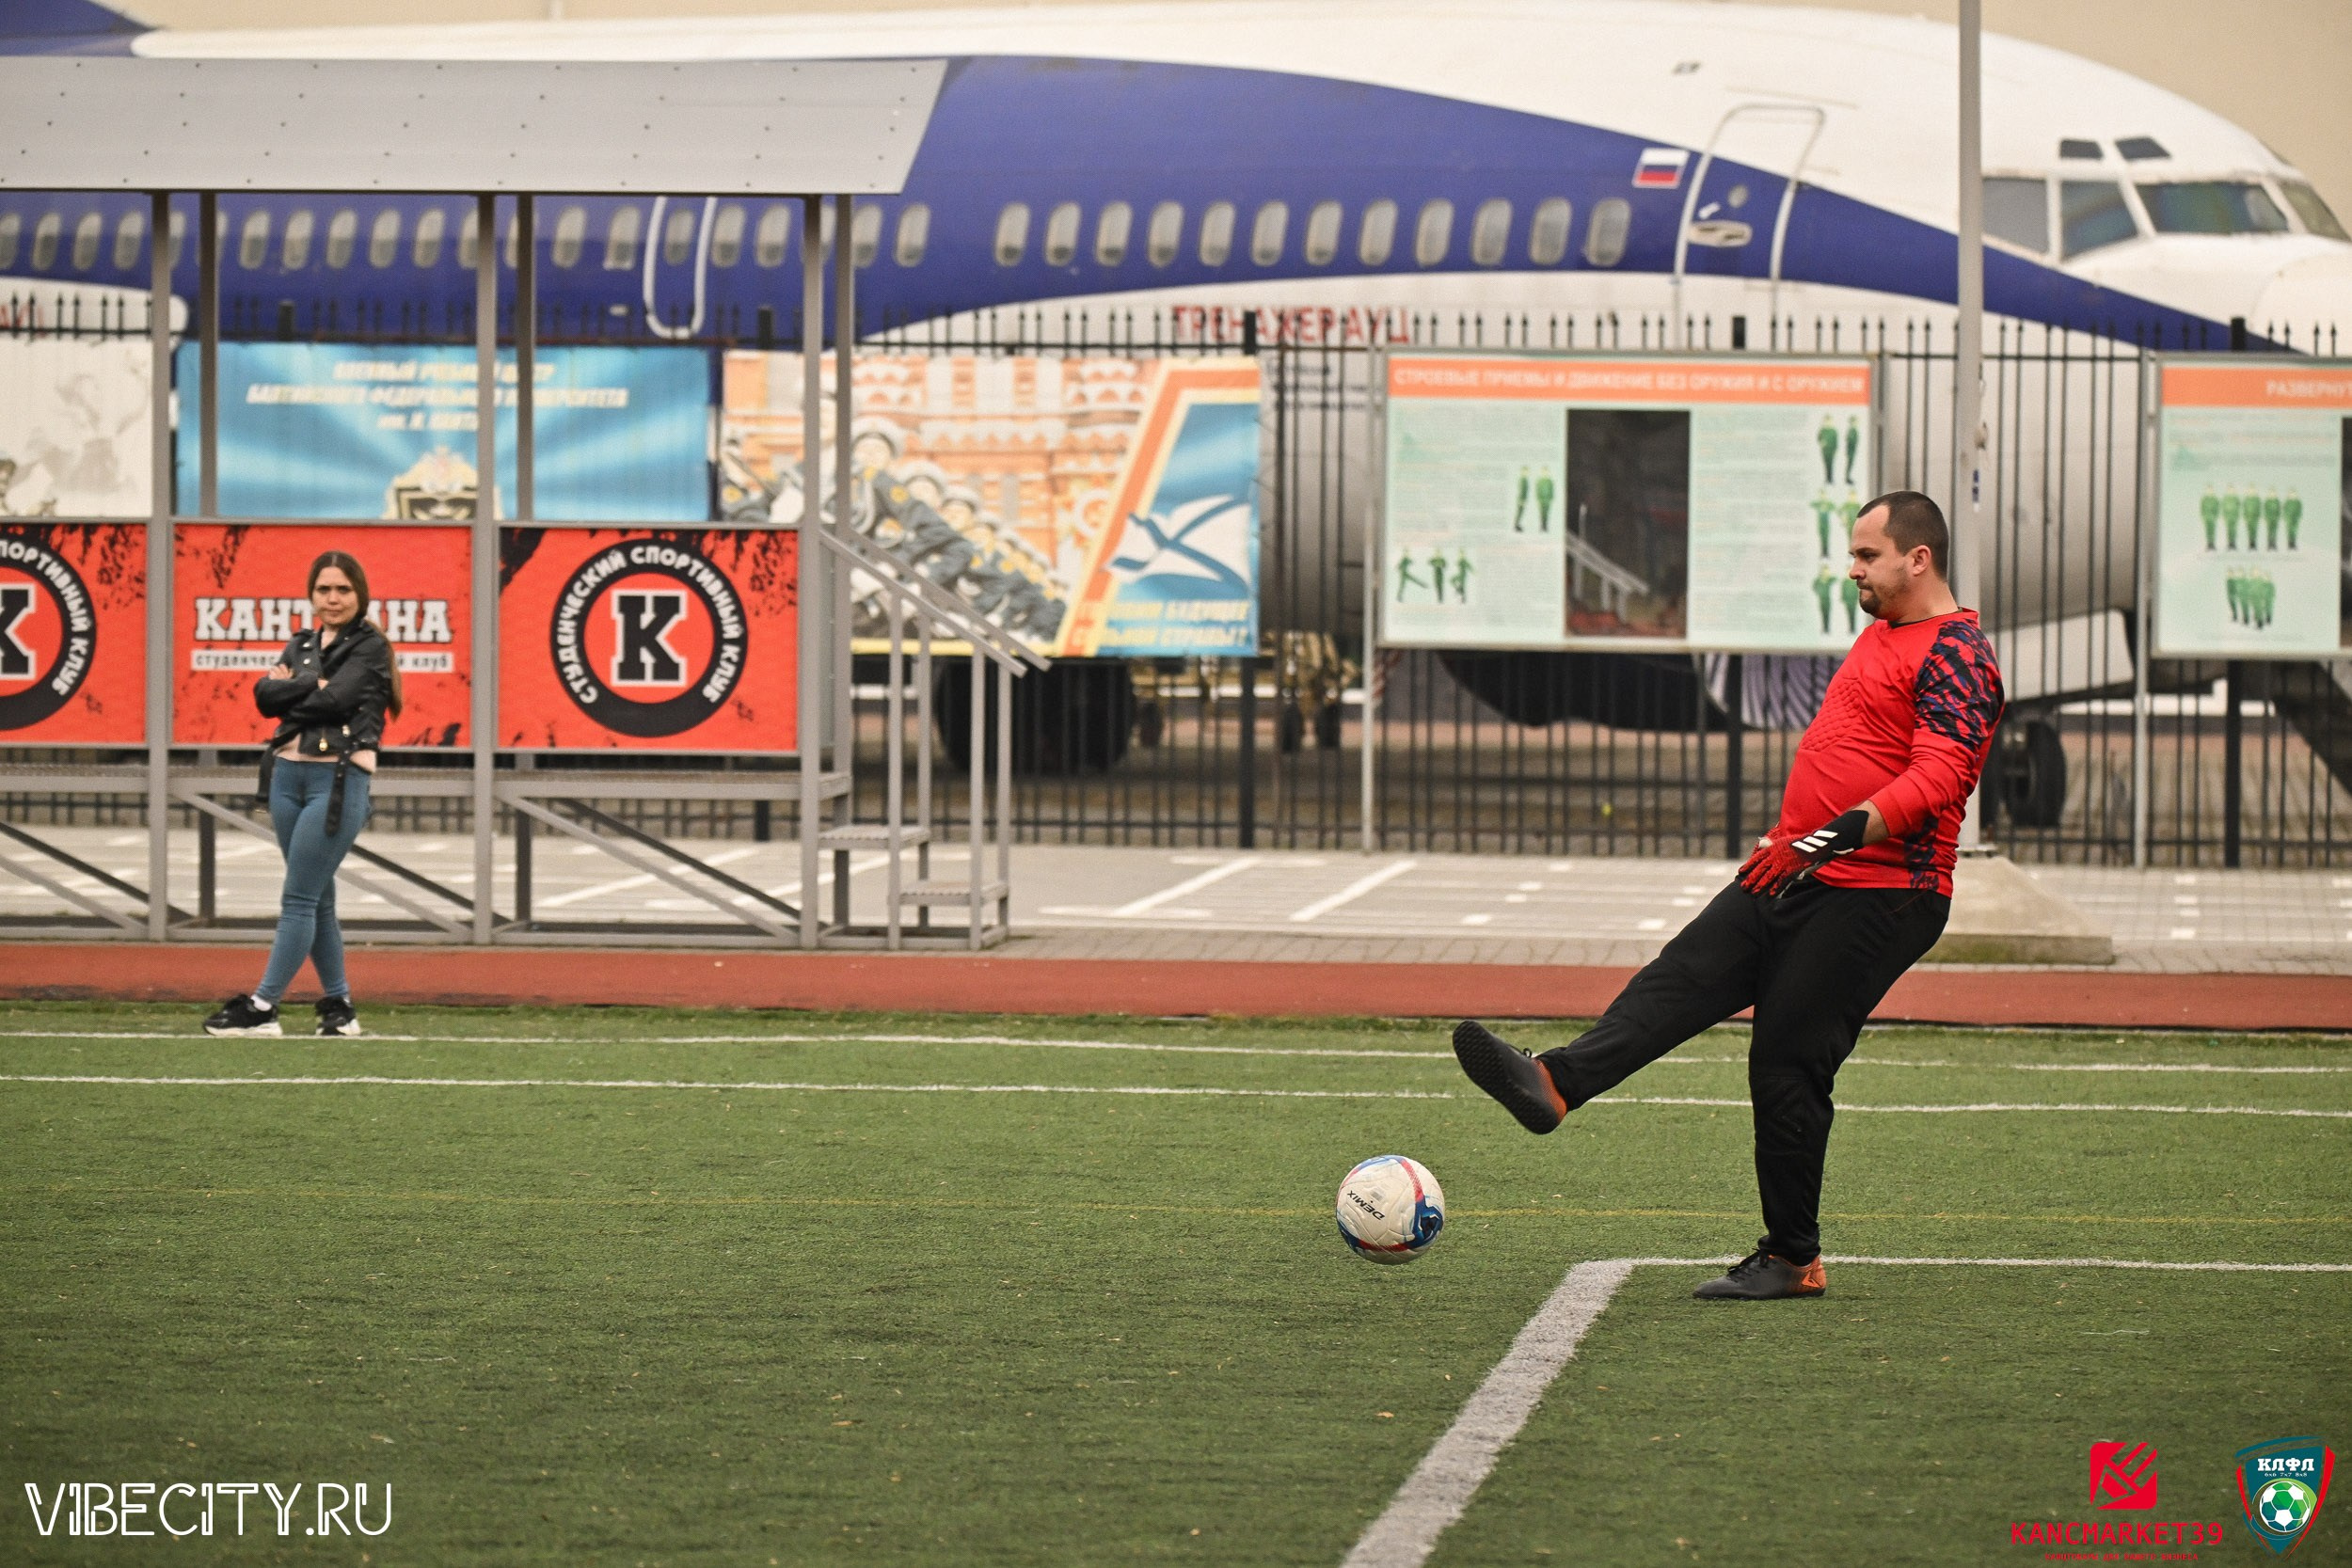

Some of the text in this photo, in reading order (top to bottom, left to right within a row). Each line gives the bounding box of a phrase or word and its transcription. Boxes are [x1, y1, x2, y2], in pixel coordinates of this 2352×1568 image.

[0, 540, 91, 632] ПОРТИВНЫЙ
[51, 637, 89, 696] КЛУБ
[557, 545, 744, 704] СТУДЕНЧЕСКИЙ СПОРТИВНЫЙ КЛУБ
[1347, 1190, 1385, 1220] DEMIX
